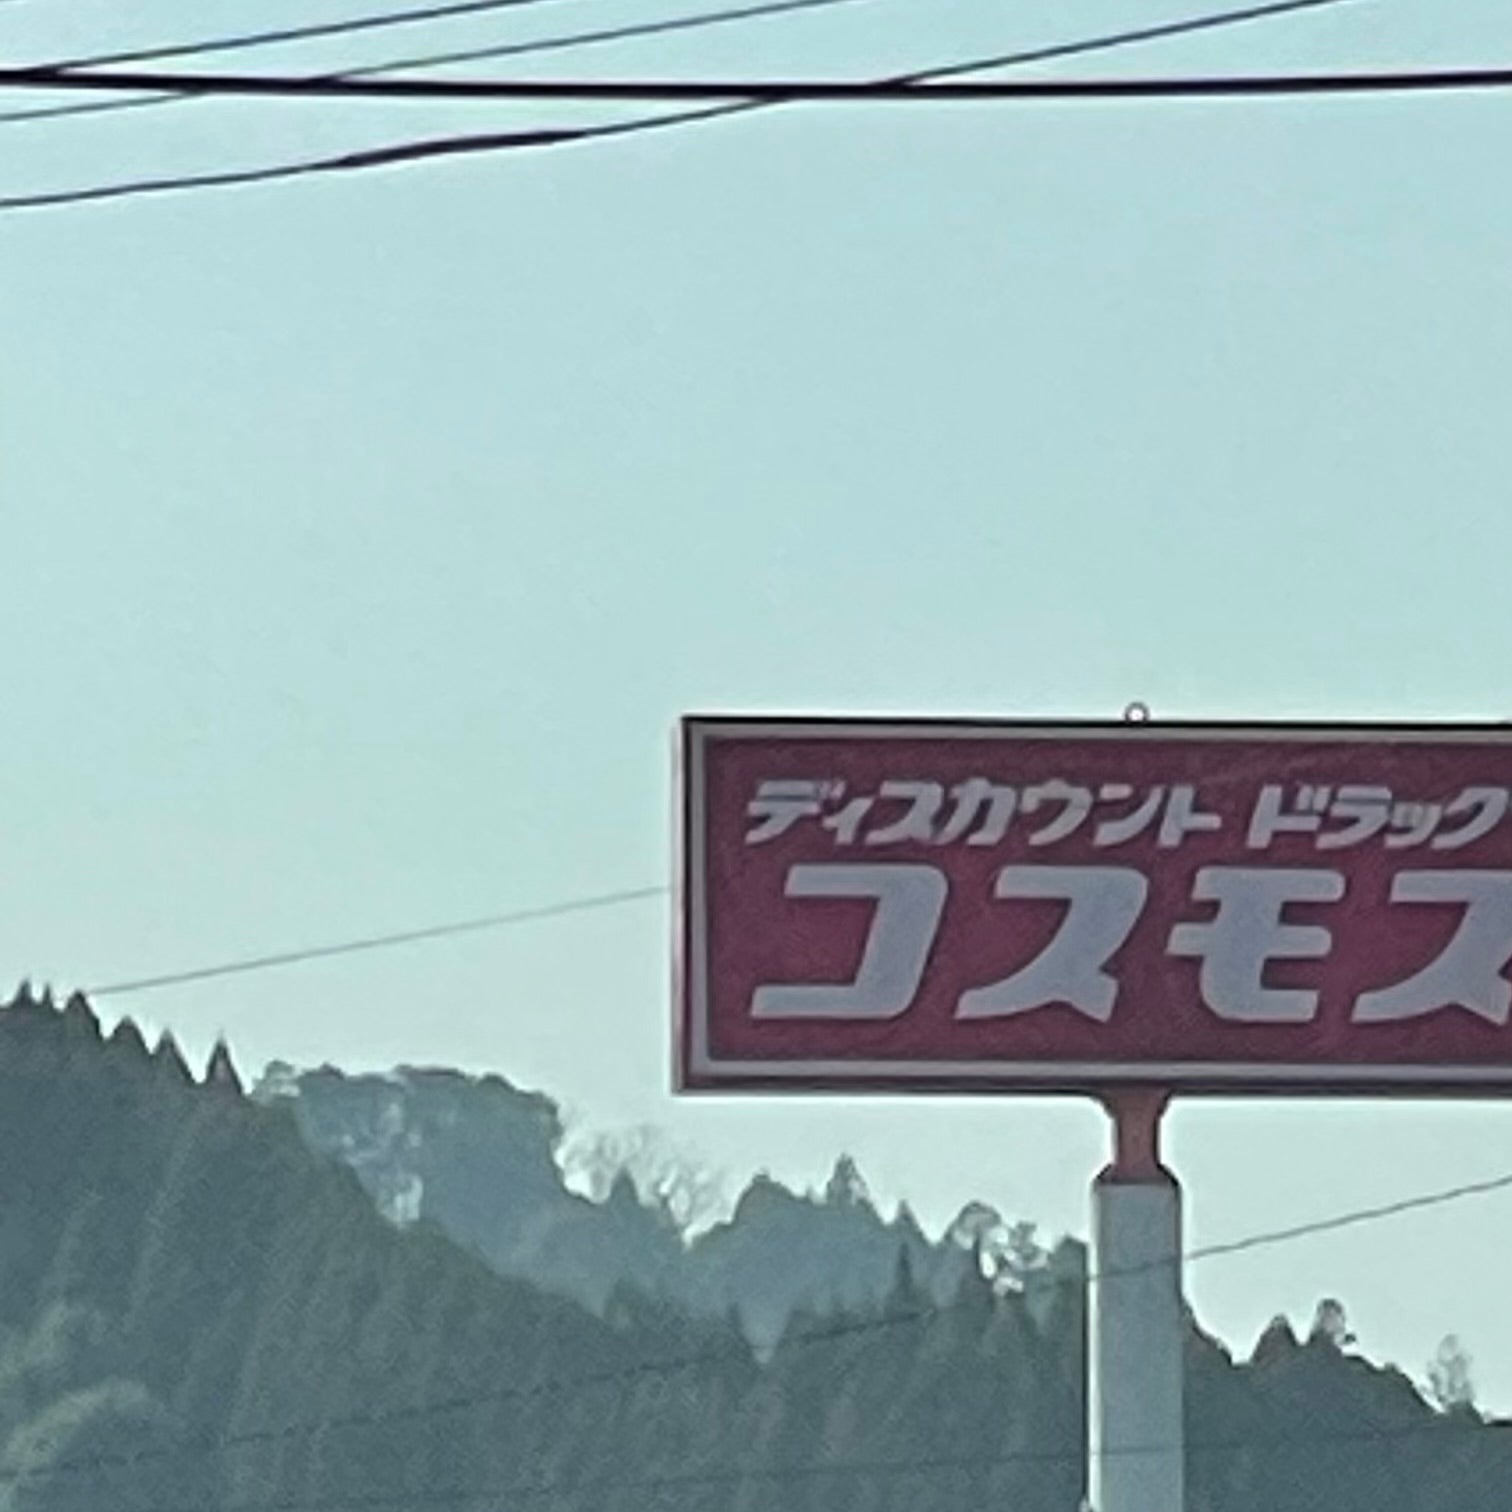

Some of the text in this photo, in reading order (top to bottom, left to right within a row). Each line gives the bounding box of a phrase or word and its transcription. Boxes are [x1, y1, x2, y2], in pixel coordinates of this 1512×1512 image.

[745, 778, 1221, 847] ディスカウント
